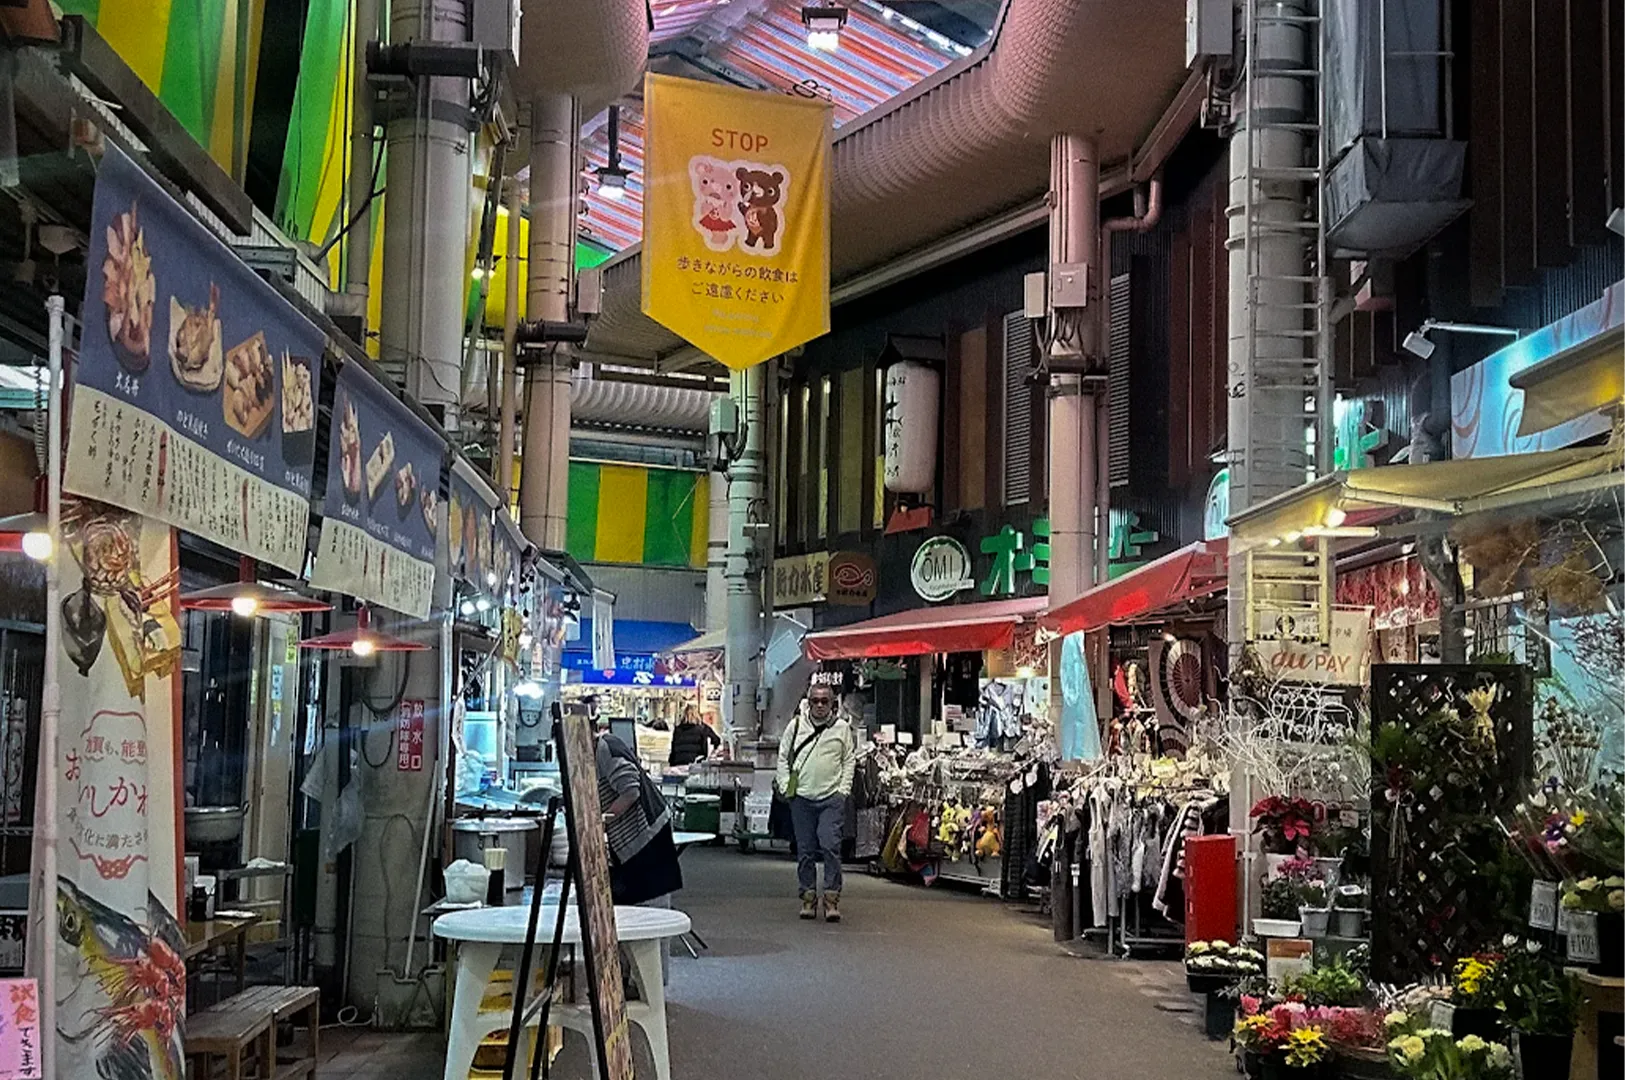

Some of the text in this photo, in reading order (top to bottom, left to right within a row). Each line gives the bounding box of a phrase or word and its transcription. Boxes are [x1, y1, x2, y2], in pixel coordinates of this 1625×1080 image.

[711, 128, 769, 153] STOP
[676, 256, 798, 284] 歩きながらの飲食は
[691, 282, 785, 304] ご遠慮ください
[1315, 654, 1352, 673] PAY
